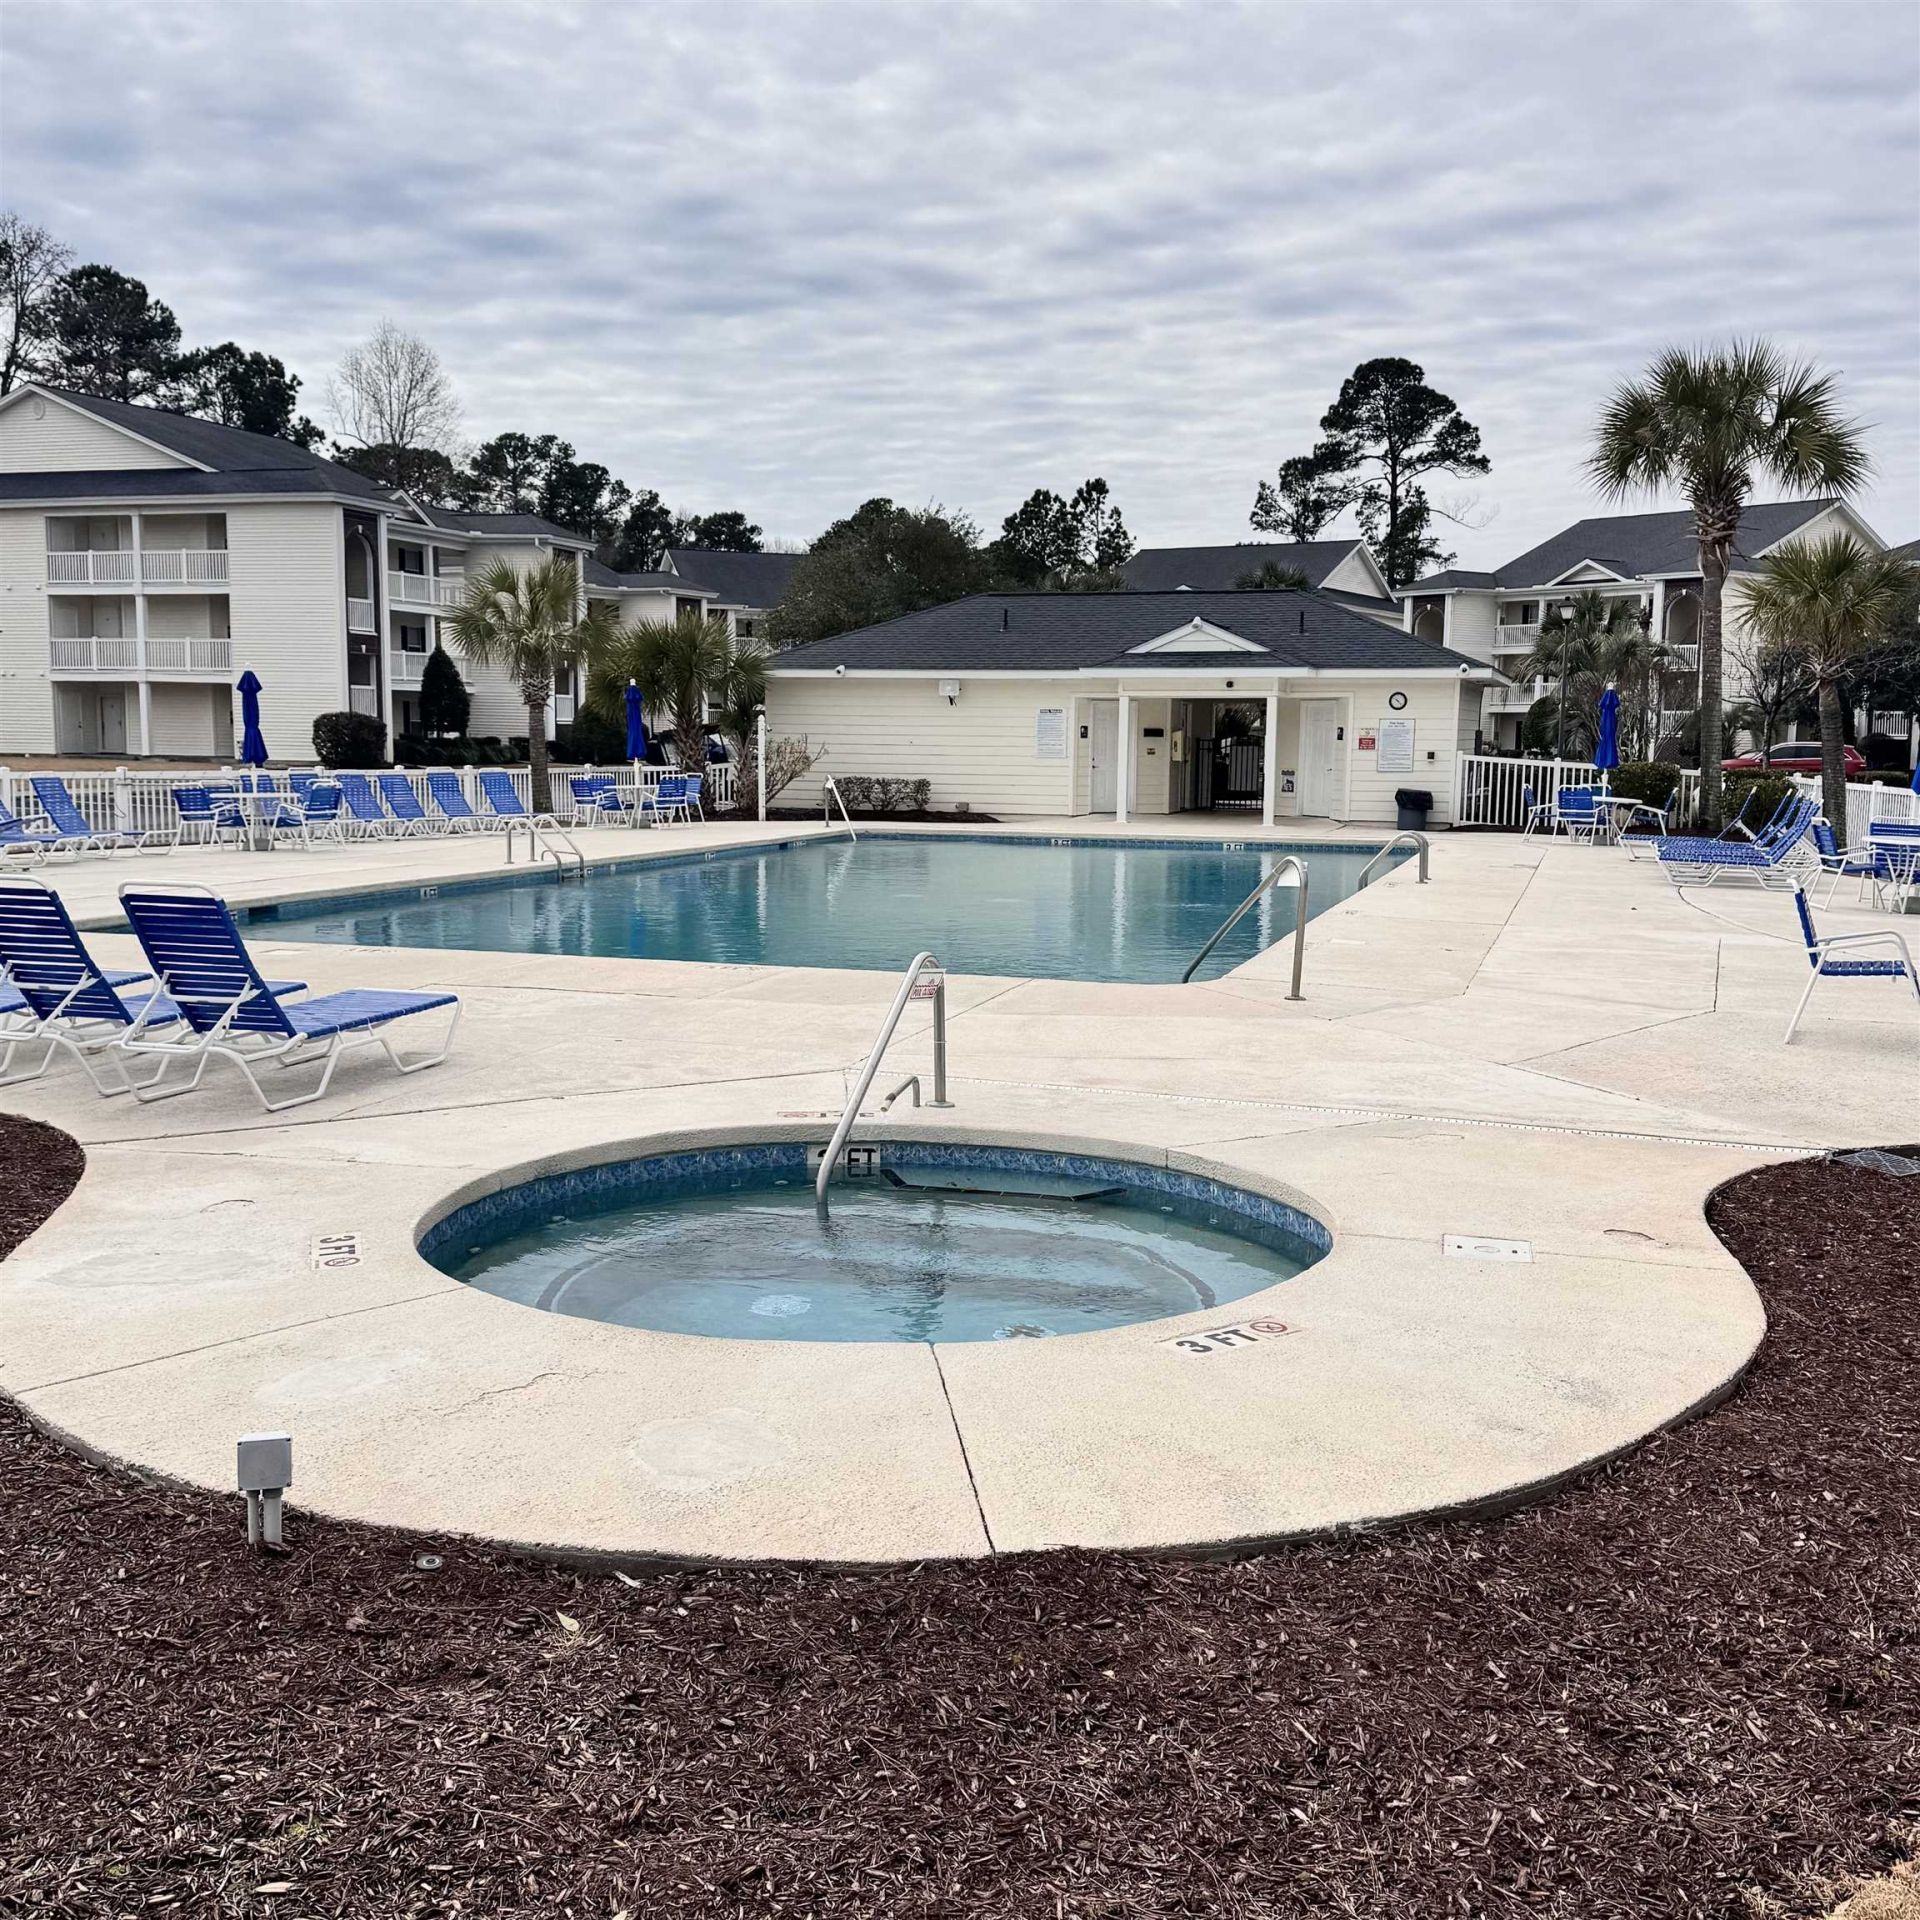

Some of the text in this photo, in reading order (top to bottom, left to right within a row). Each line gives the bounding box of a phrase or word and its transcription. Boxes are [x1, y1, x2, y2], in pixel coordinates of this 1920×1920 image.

[319, 1235, 356, 1256] 3 FT
[1175, 1340, 1213, 1353] 3
[1204, 1329, 1258, 1347] FT
